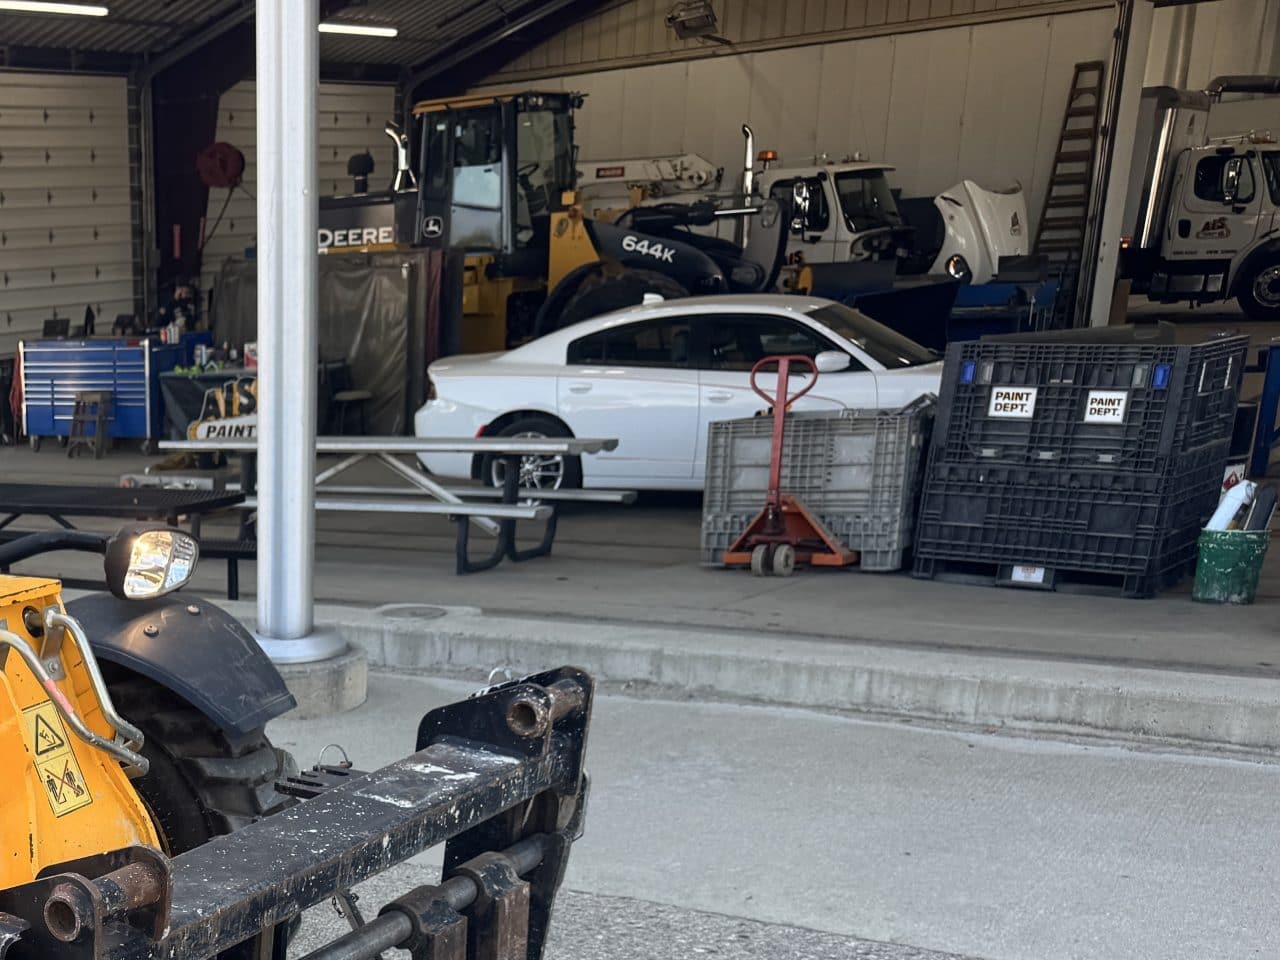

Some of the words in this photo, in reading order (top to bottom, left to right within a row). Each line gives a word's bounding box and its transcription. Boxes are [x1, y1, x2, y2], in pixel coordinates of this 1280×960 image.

[317, 226, 393, 248] DEERE
[622, 235, 676, 264] 644K
[995, 391, 1032, 402] PAINT
[1089, 397, 1123, 407] PAINT
[994, 402, 1029, 414] DEPT.
[1088, 407, 1121, 417] DEPT.
[205, 424, 257, 439] PAINT
